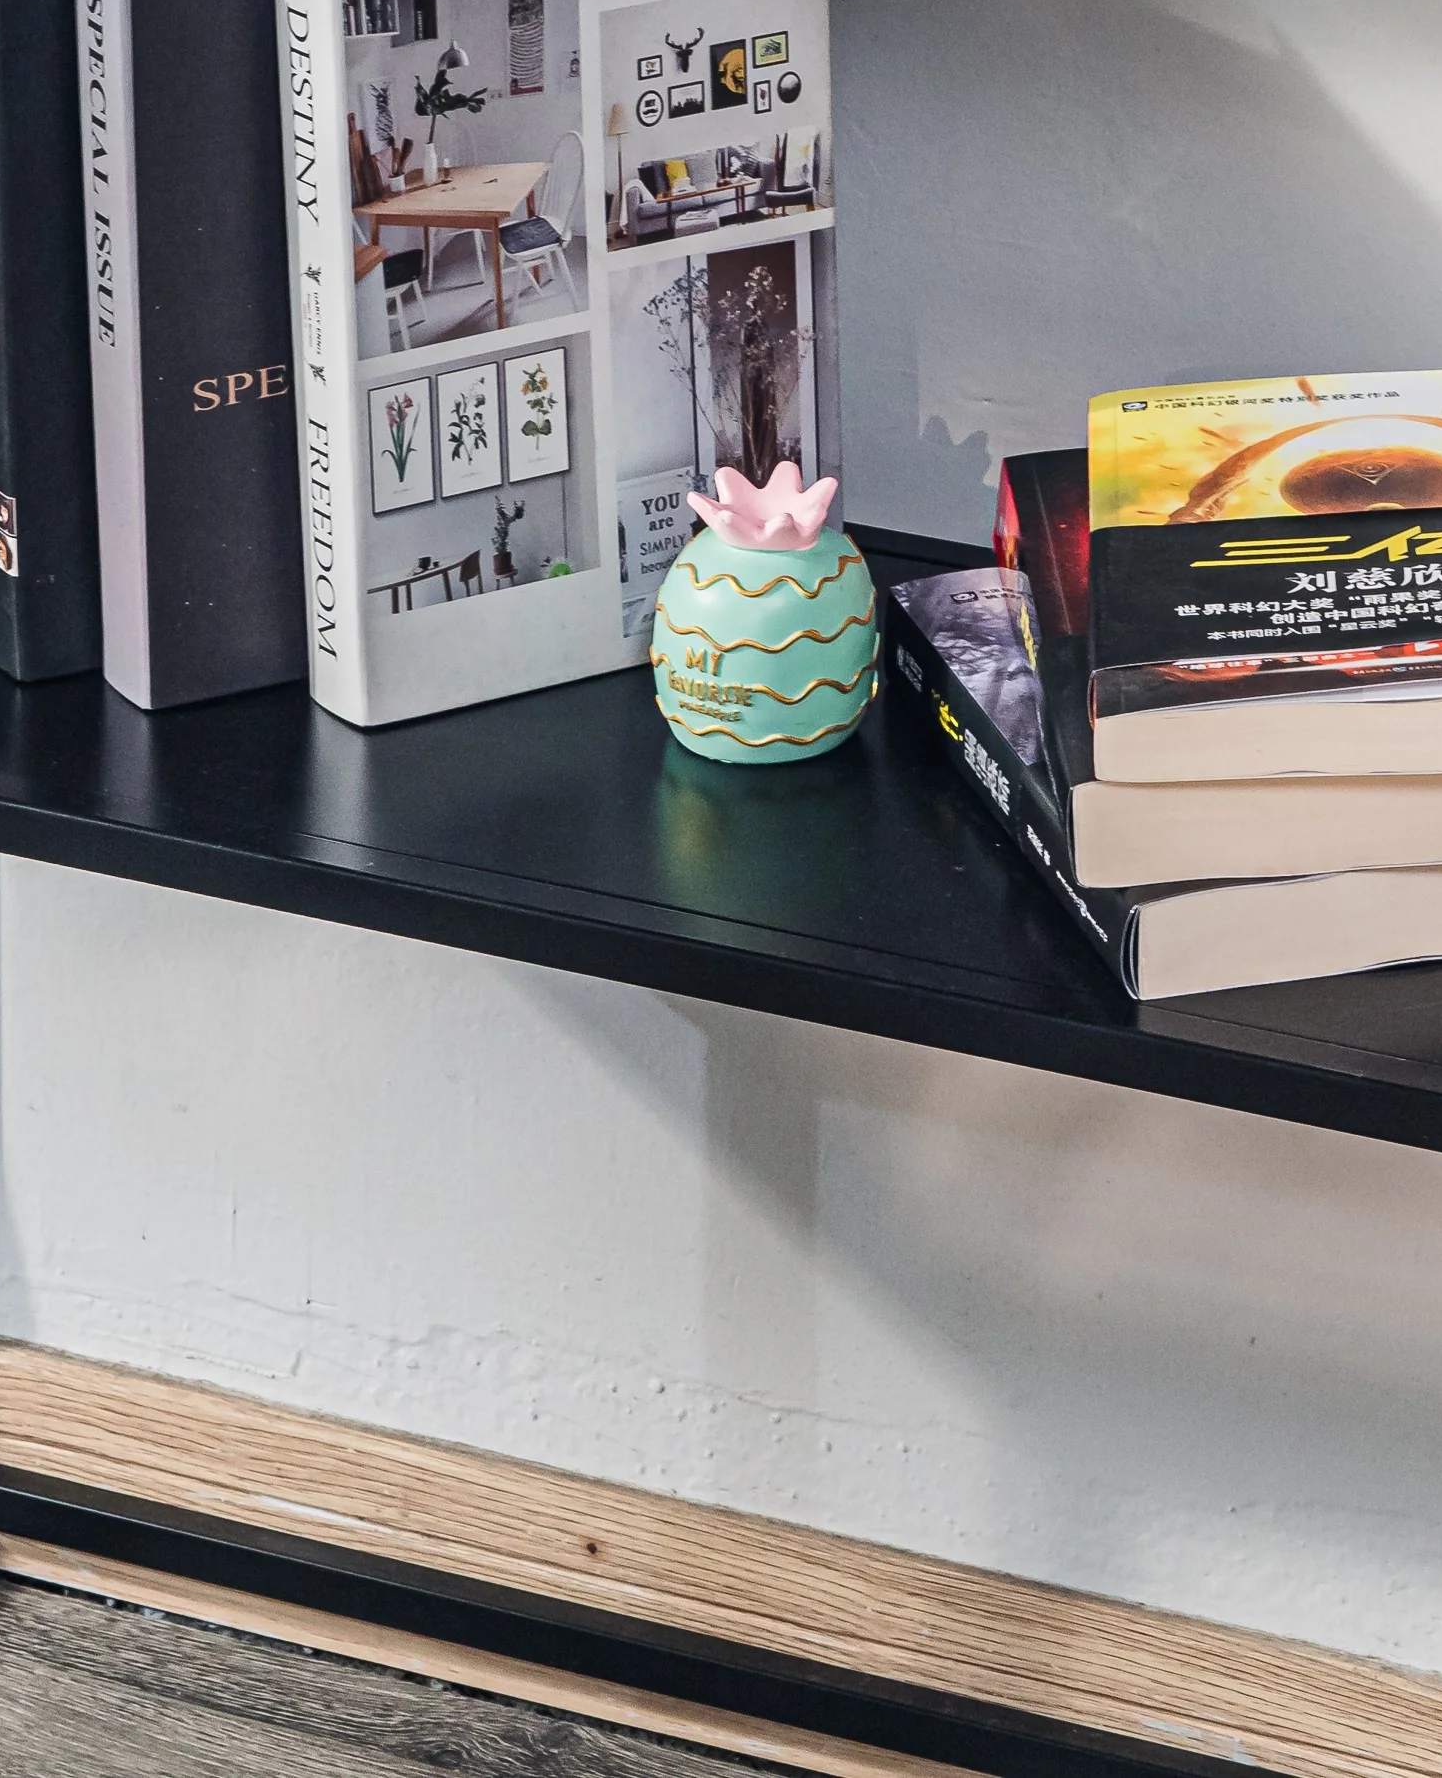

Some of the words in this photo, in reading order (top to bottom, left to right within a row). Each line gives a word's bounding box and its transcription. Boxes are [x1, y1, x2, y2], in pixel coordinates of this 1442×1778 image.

[286, 4, 320, 228] DESTINY
[92, 207, 118, 349] ISSUE
[192, 364, 291, 413] SPE
[641, 491, 681, 516] YOU
[648, 516, 674, 532] are
[307, 415, 340, 663] FREEDOM
[639, 533, 687, 557] SIMPLY
[1173, 597, 1335, 617] 世界科幻大奖
[1206, 625, 1322, 641] 本书同时入围
[685, 645, 722, 677] MY
